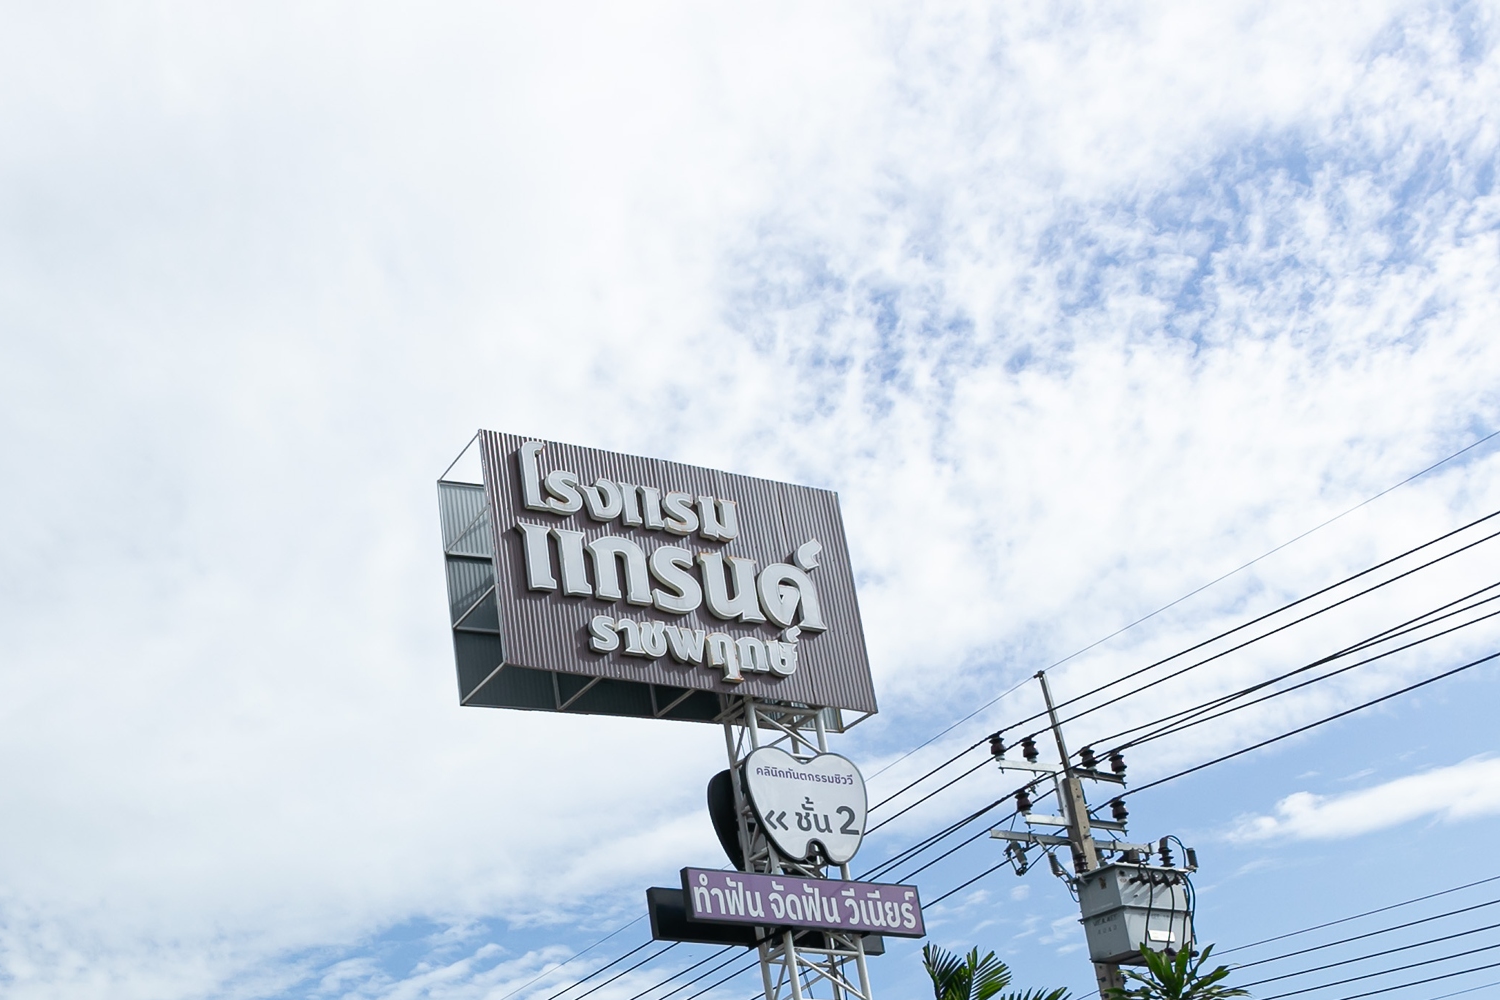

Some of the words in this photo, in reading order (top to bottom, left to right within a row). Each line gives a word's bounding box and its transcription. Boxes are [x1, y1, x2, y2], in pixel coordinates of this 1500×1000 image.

[518, 440, 738, 543] โรงแรม
[516, 522, 827, 633] แกรนด์
[589, 615, 802, 684] ราชพฤกษ์
[795, 796, 833, 834] ชั้น
[836, 805, 860, 836] 2
[693, 873, 765, 918] ทำฟัน
[768, 880, 841, 924] จัดฟัน
[841, 888, 917, 929] วีเนียร์
